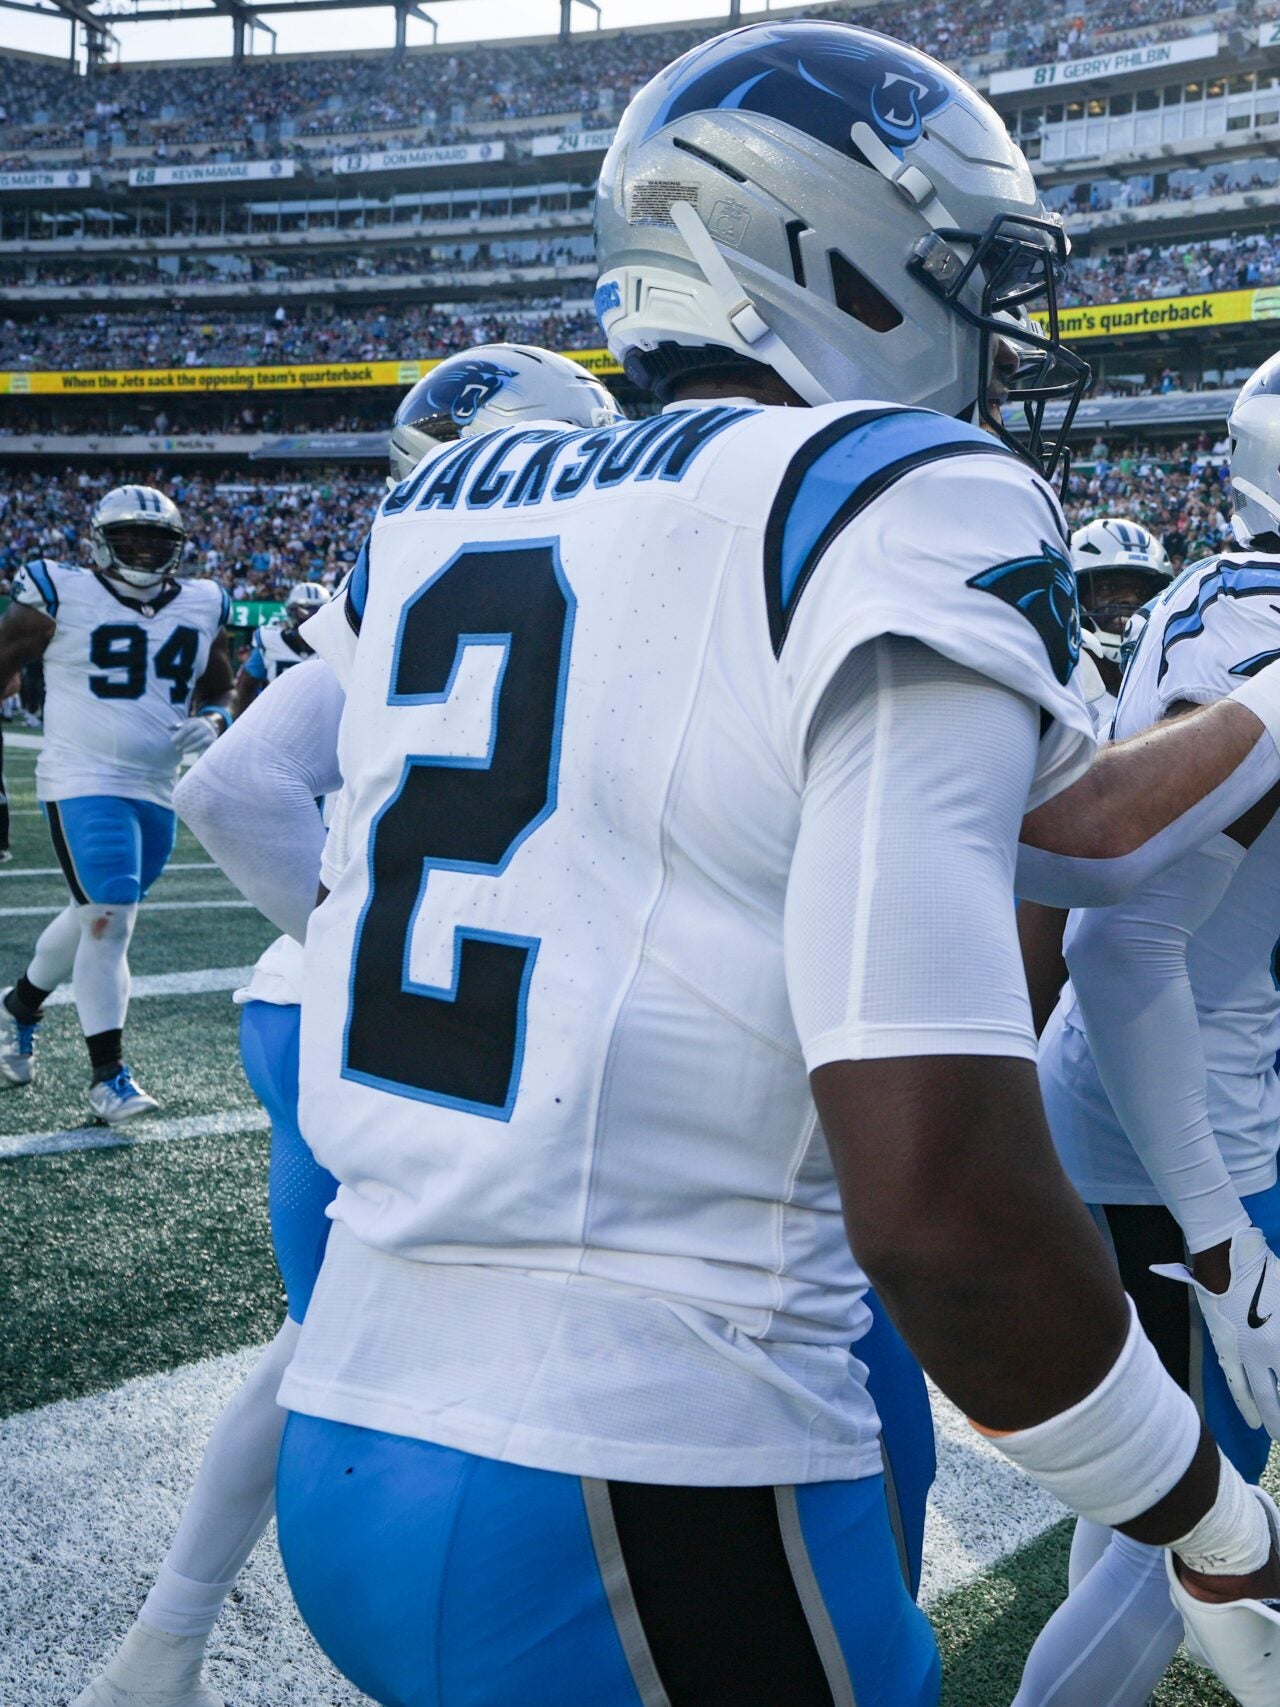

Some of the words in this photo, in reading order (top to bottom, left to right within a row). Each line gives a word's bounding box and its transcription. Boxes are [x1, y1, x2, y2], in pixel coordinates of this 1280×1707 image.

[1034, 66, 1056, 85] 81
[1063, 58, 1112, 79] GERRY
[1115, 46, 1172, 68] PHILBIN
[1100, 299, 1213, 332] quarterback
[62, 374, 96, 388] When
[98, 374, 118, 387] the
[120, 374, 145, 387] Jets
[148, 373, 174, 386] sack
[177, 372, 197, 386] the
[200, 370, 255, 389] opposing
[257, 369, 297, 385] team's
[298, 366, 373, 387] quarterback
[382, 405, 764, 516] JACKSON
[89, 624, 200, 705] 94
[340, 534, 577, 1124] 2
